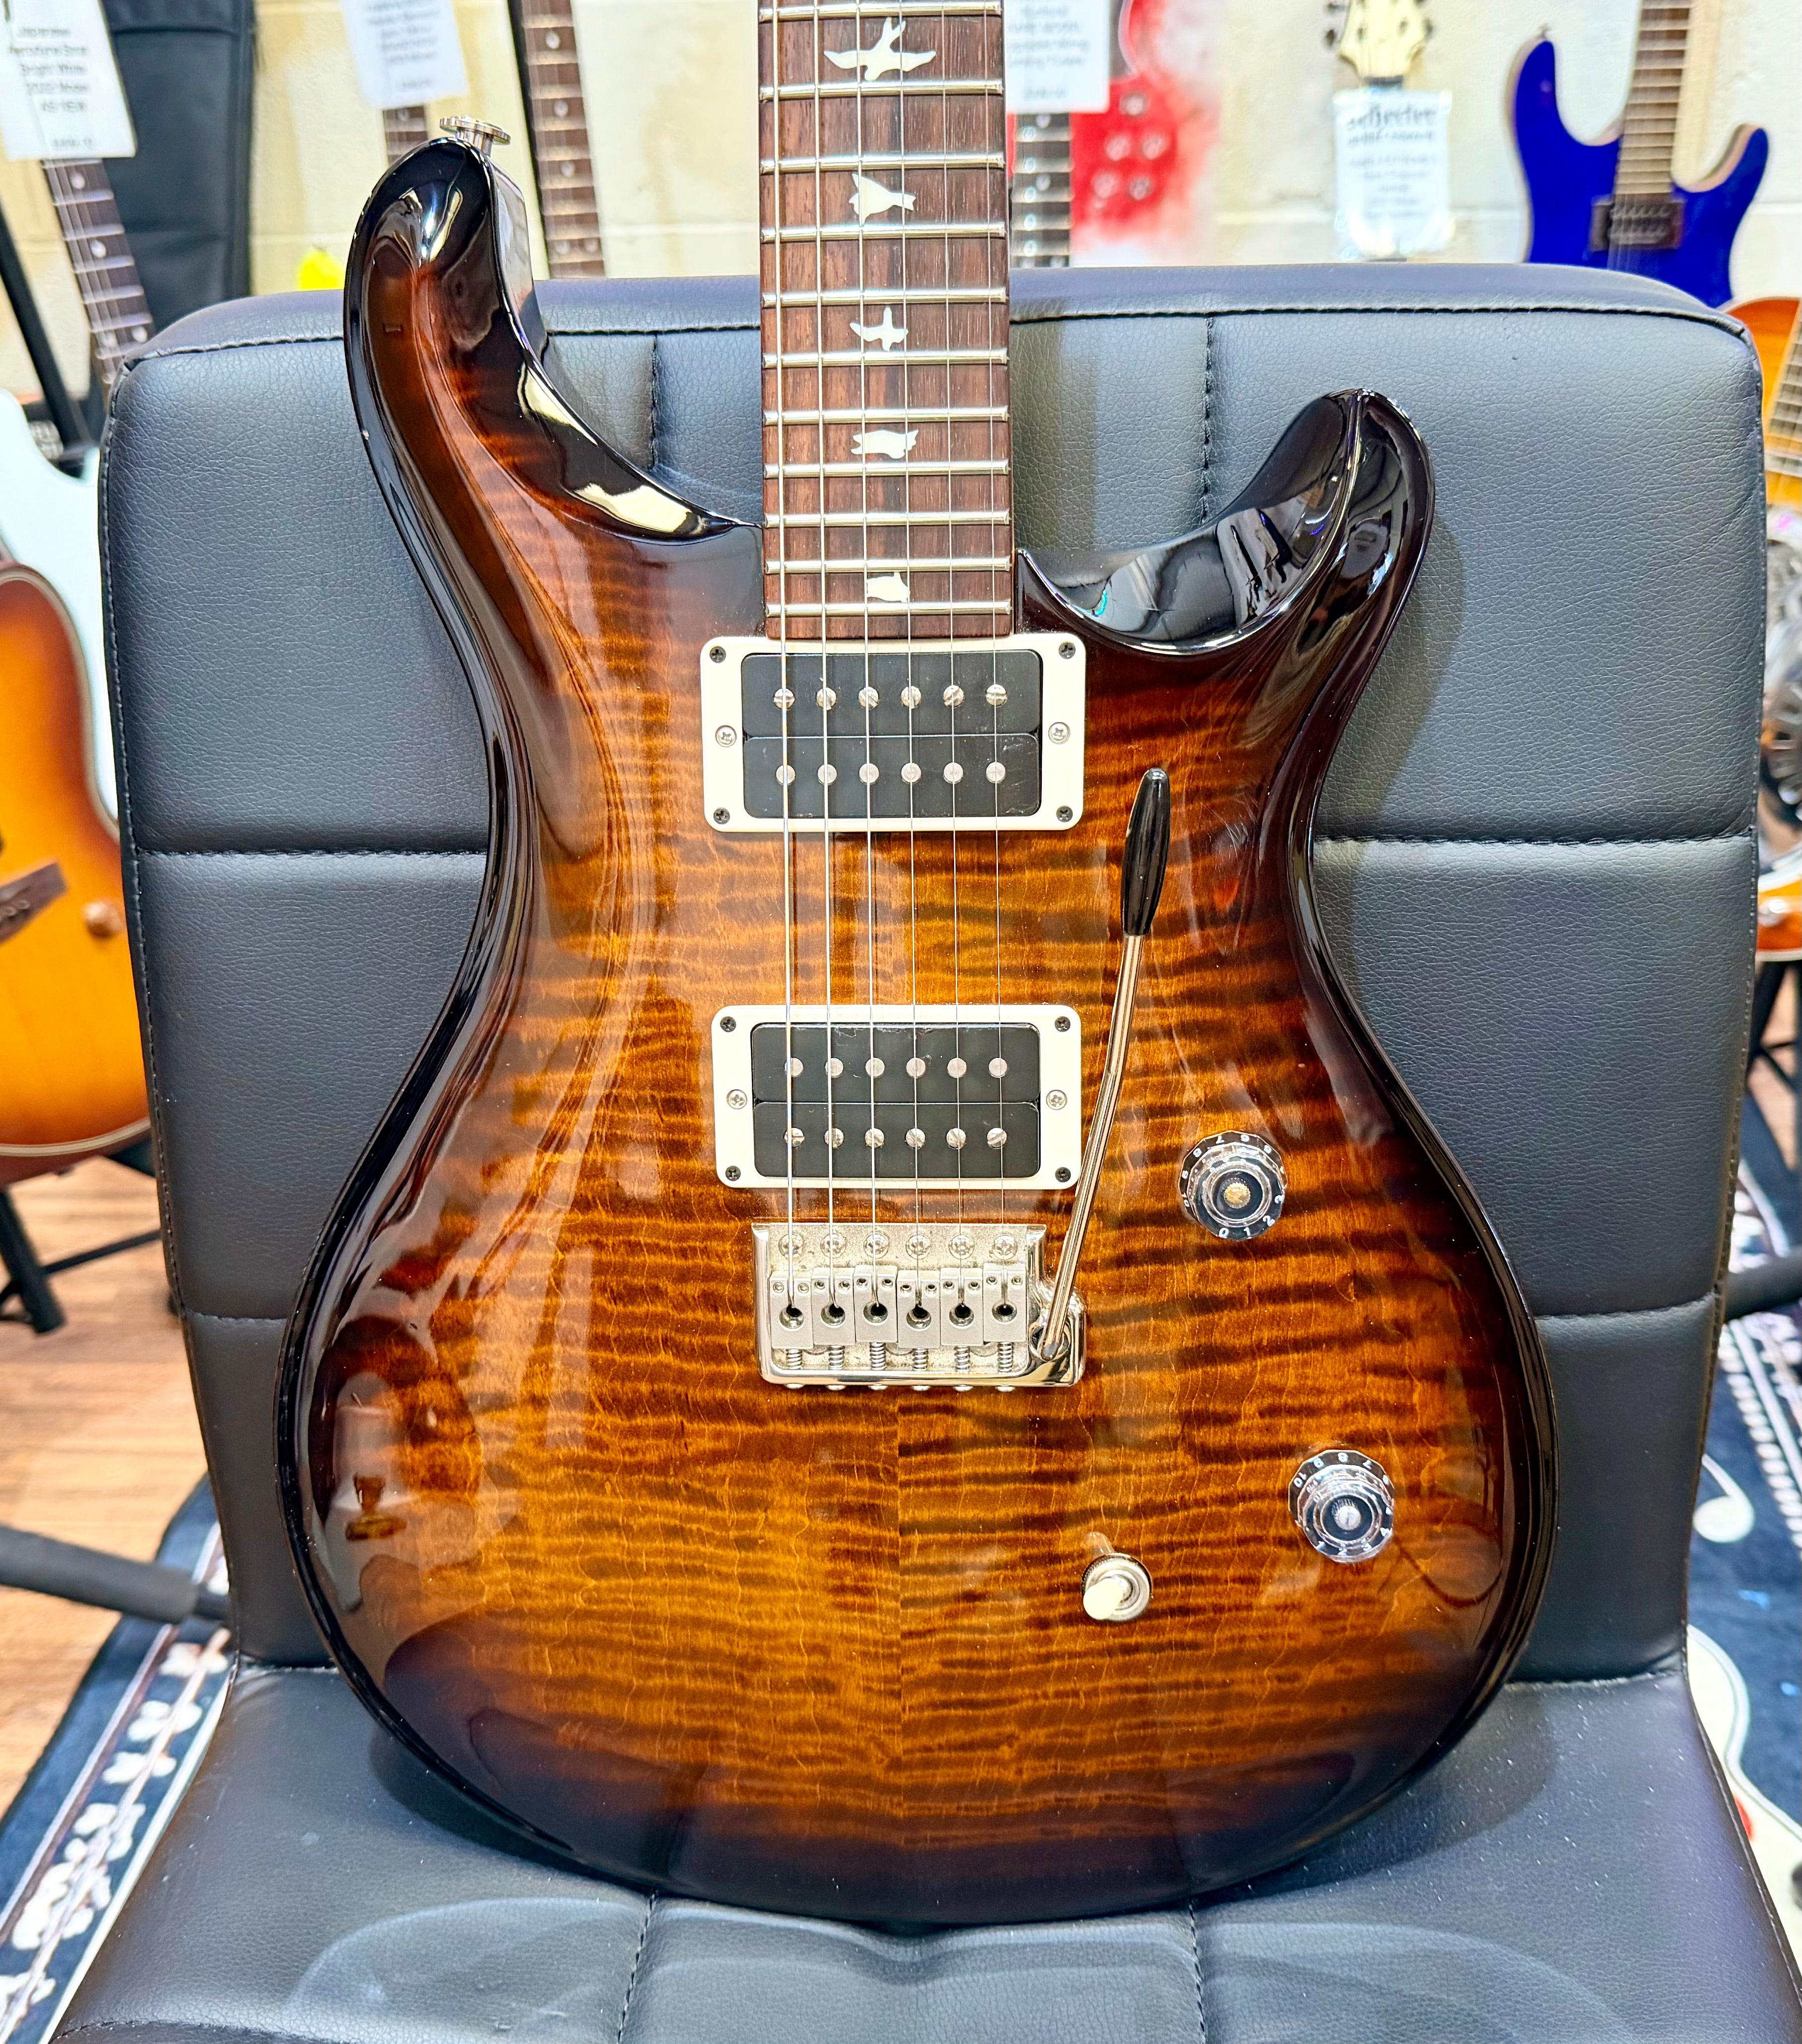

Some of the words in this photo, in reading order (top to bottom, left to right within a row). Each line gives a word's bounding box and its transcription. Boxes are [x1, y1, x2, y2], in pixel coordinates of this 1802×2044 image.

[1263, 1215, 1275, 1227] 2
[1219, 1227, 1230, 1238] 0
[1243, 1227, 1252, 1236] 1
[1337, 1452, 1348, 1462] 8
[1294, 1472, 1307, 1488] 10
[1337, 1547, 1347, 1556] 2
